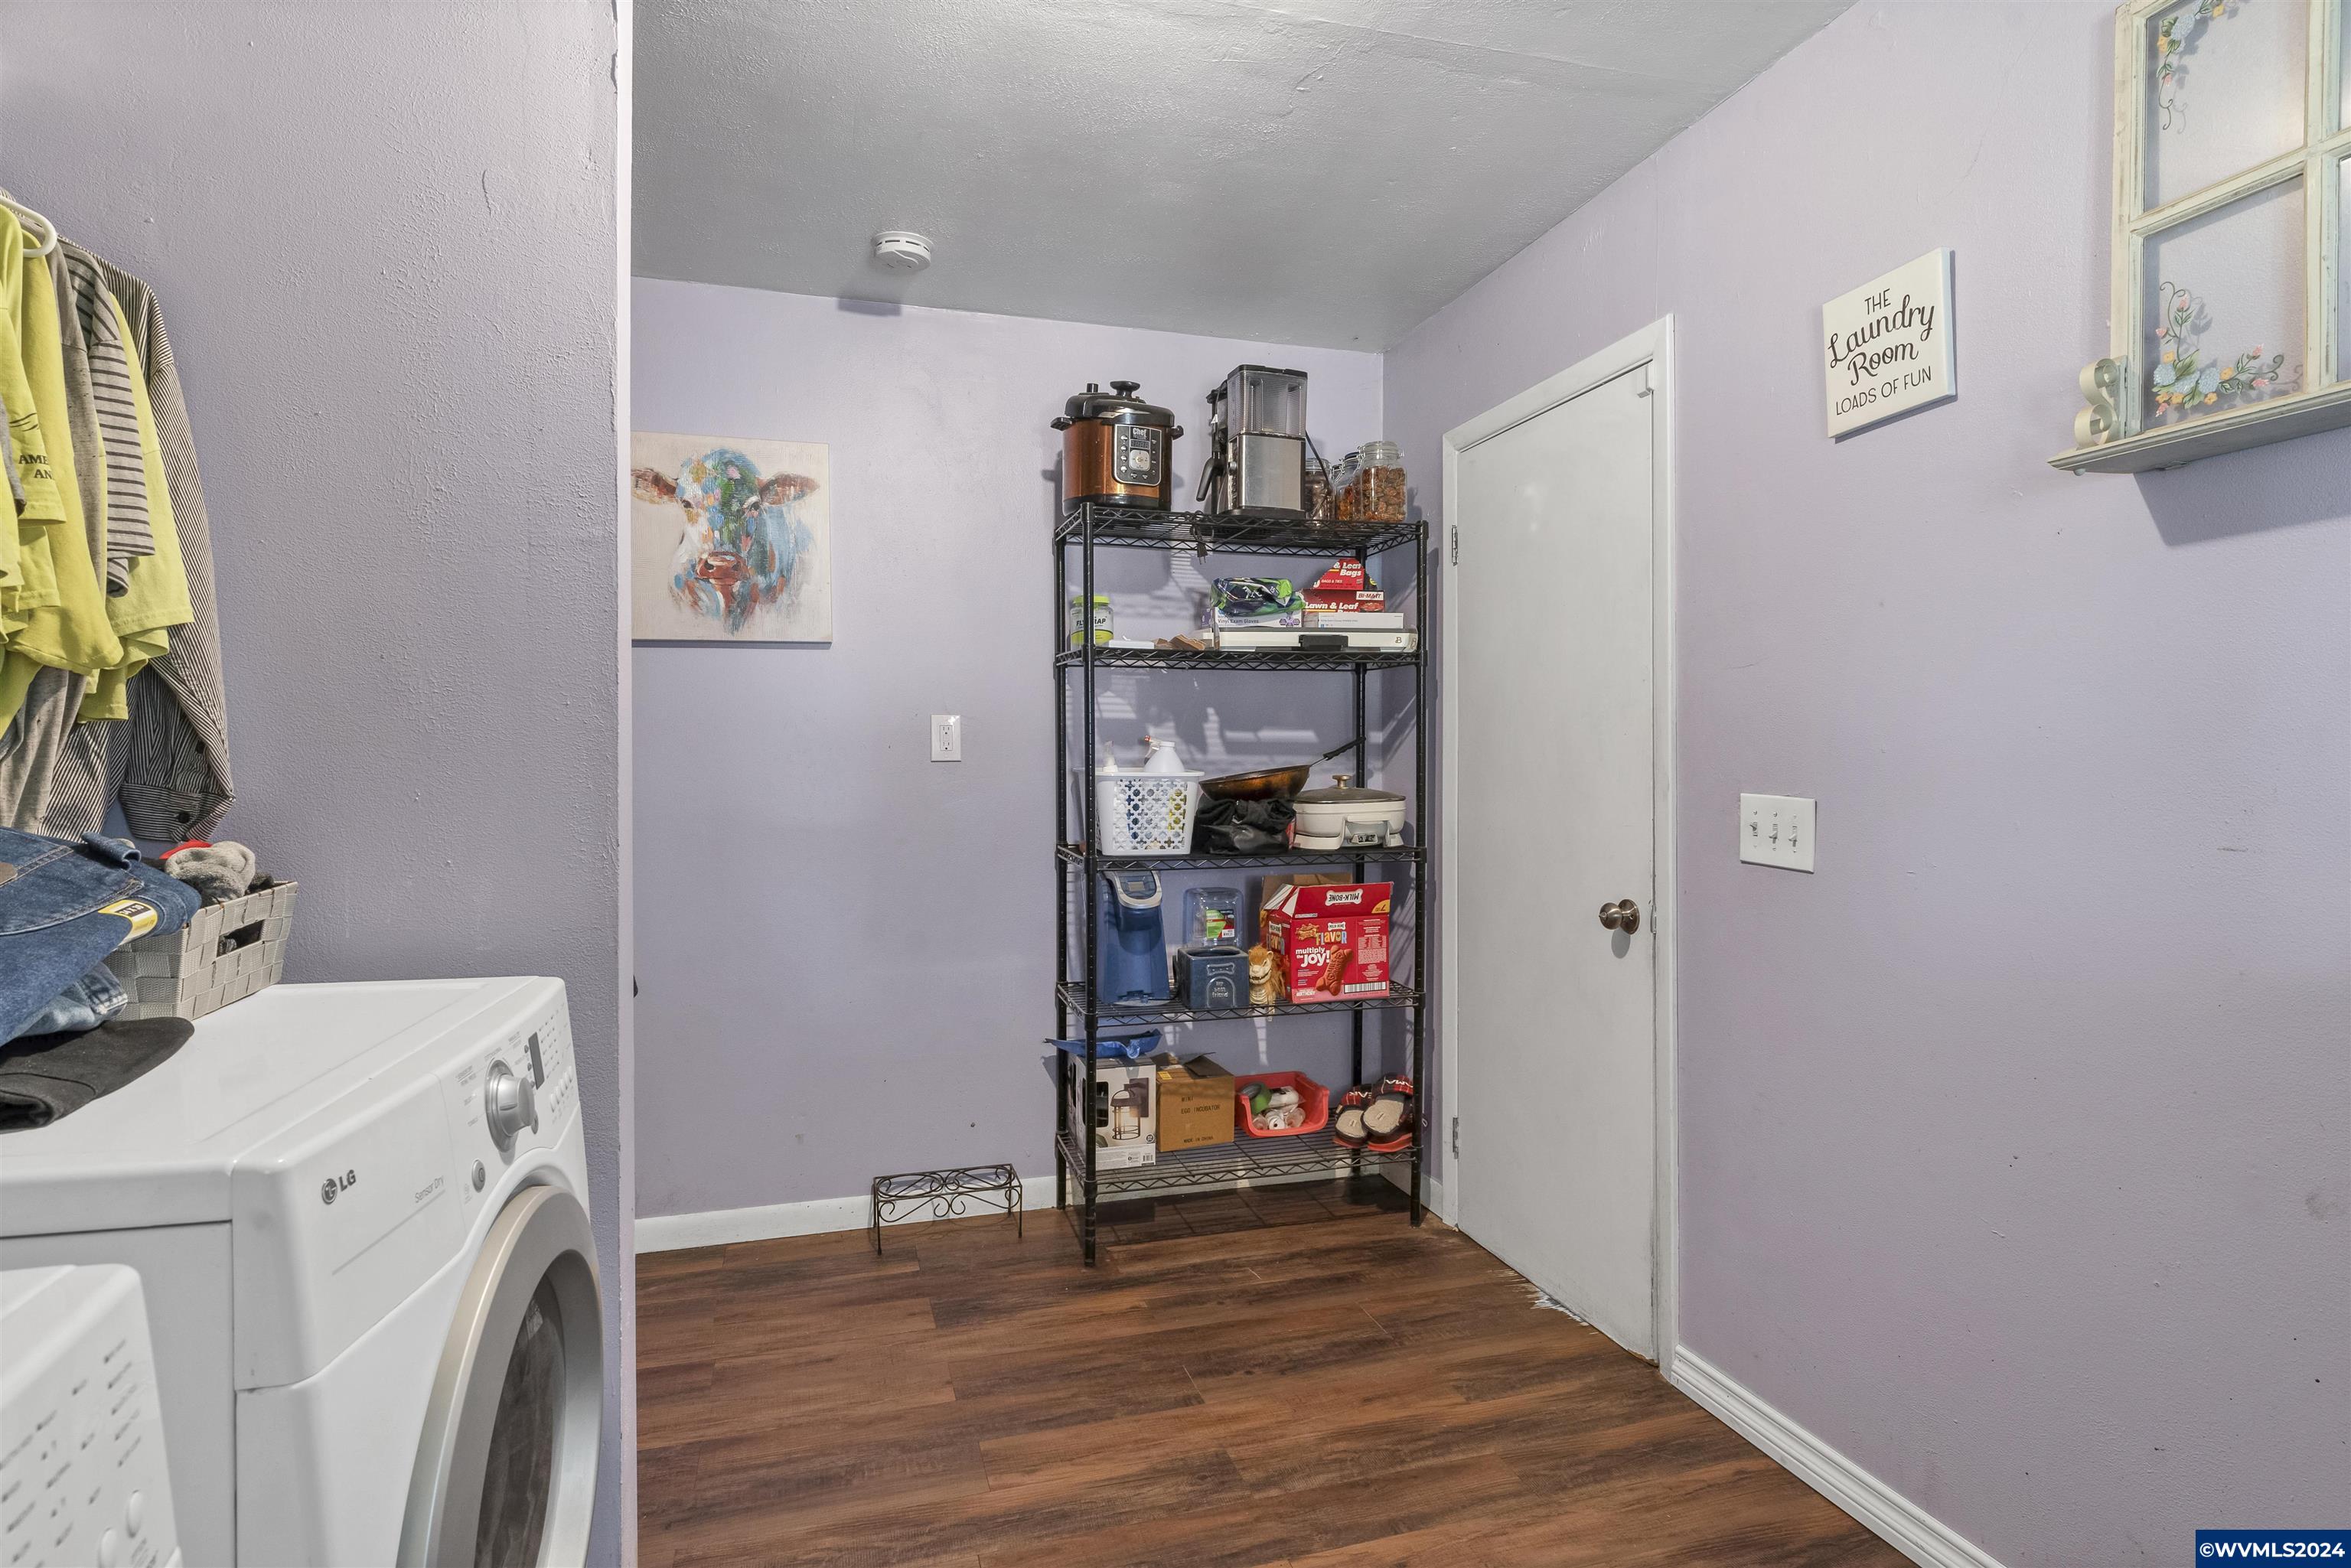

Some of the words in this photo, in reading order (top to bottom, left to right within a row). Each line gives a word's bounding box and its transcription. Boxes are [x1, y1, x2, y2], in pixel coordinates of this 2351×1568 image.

[1864, 288, 1891, 315] THE
[1828, 294, 1935, 368] Laundry
[1847, 342, 1919, 386] Room
[1836, 387, 1877, 416] LOADS
[1881, 378, 1899, 398] OF
[1903, 366, 1932, 391] FUN
[1133, 428, 1147, 438] Chef
[1340, 569, 1361, 578] Bags
[1296, 947, 1325, 955] multiply
[1193, 1104, 1221, 1113] INCUBATOR
[339, 1169, 357, 1191] LG
[415, 1182, 434, 1204] Sensor
